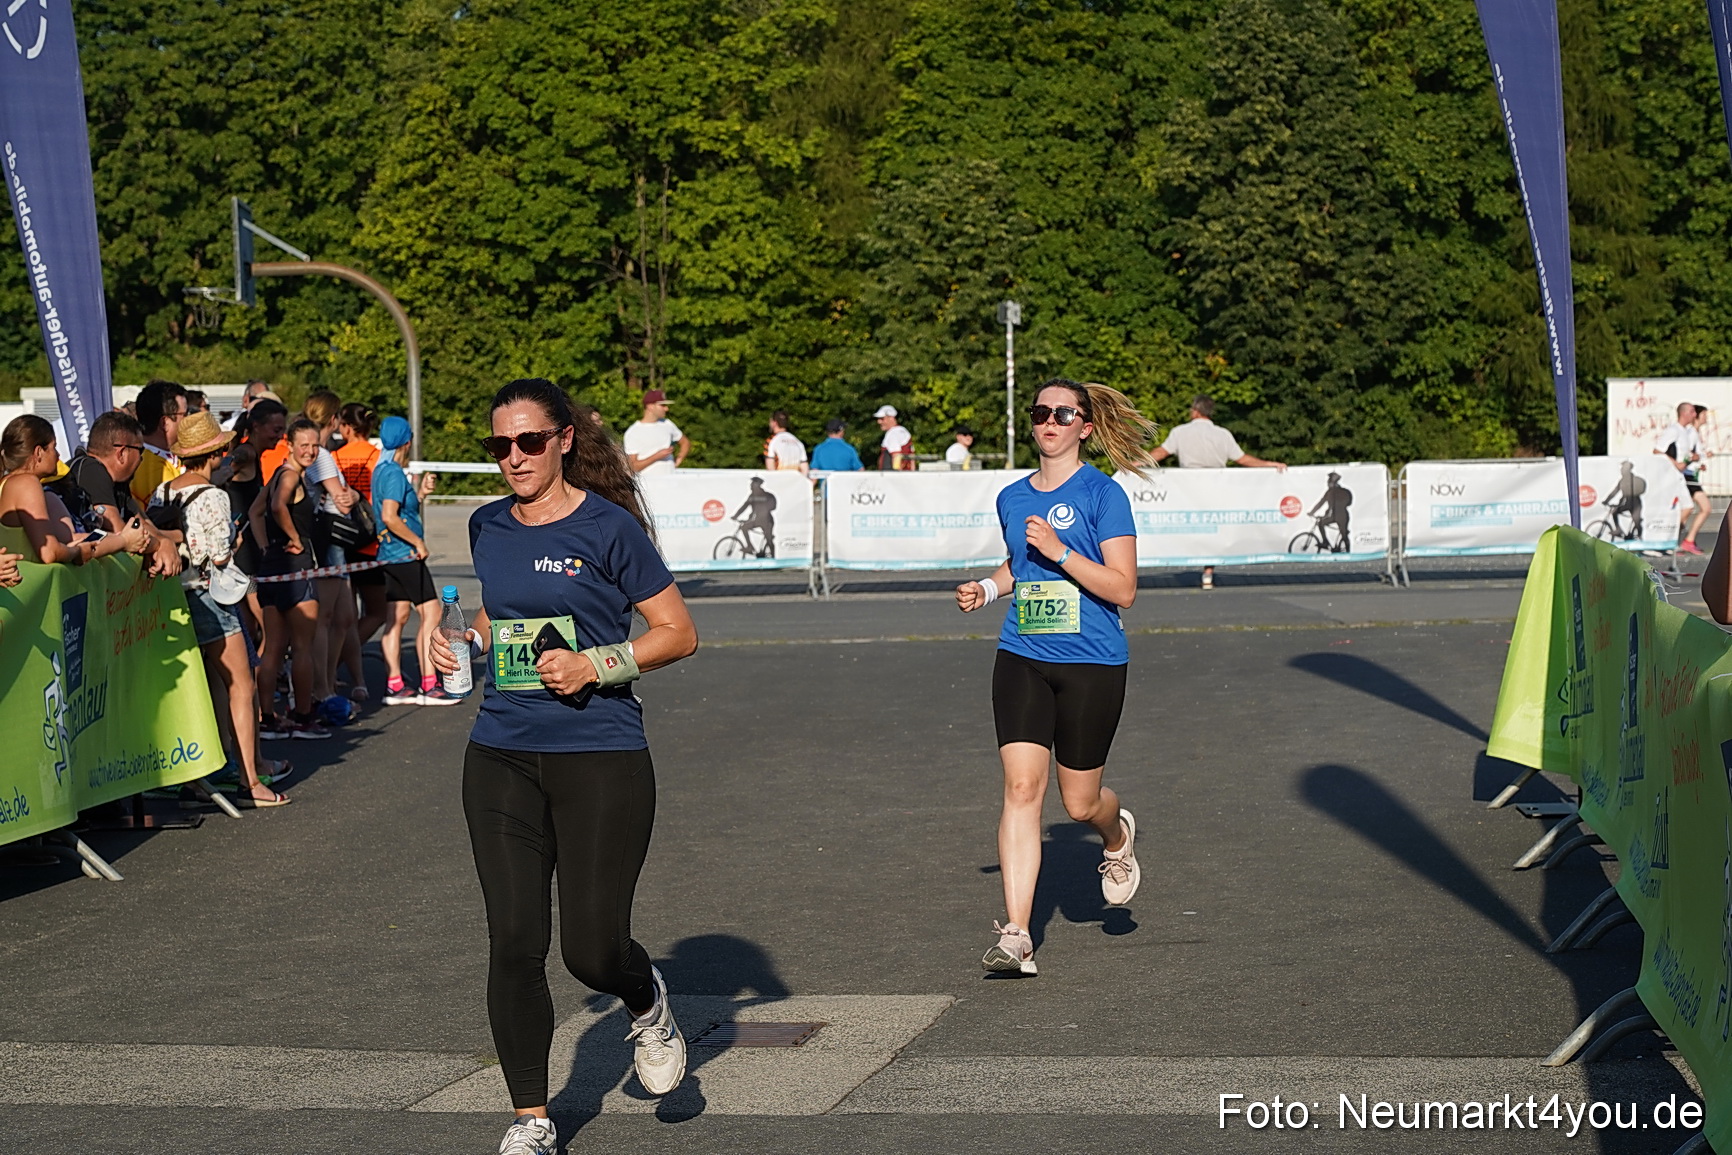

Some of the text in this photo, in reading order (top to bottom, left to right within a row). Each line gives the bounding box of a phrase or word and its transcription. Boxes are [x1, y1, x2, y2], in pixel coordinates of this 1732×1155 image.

[1133, 490, 1168, 503] NOW
[1430, 484, 1466, 496] NOW
[851, 493, 886, 505] NOW
[1137, 513, 1187, 524] E-BIKES
[1189, 512, 1199, 523] &
[1432, 506, 1481, 518] E-BIKES
[1484, 505, 1494, 516] &
[853, 516, 904, 527] E-BIKES
[907, 516, 917, 527] &
[534, 556, 563, 573] vhs
[1025, 599, 1067, 616] 1752
[1069, 601, 1077, 626] 2022
[505, 644, 540, 667] 14
[506, 669, 522, 677] Hierl
